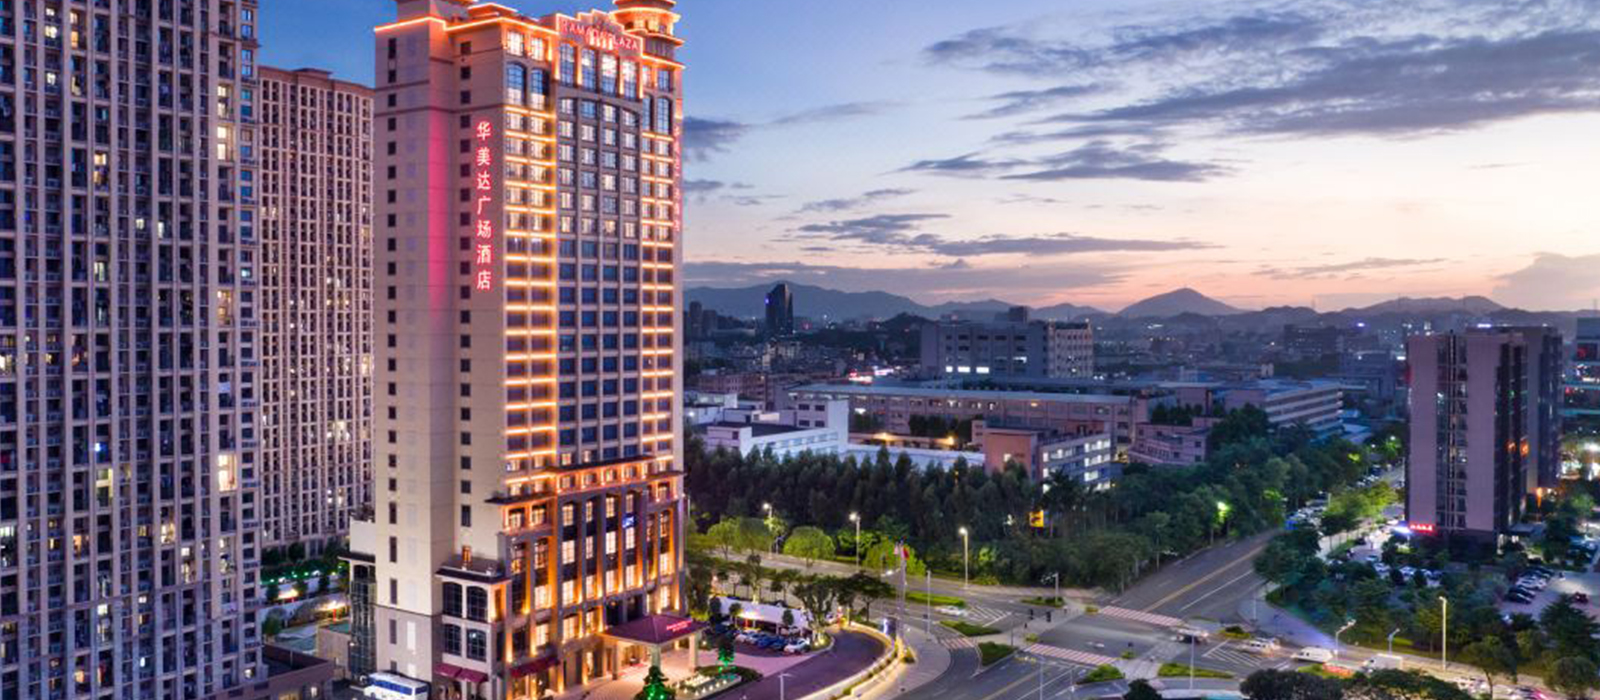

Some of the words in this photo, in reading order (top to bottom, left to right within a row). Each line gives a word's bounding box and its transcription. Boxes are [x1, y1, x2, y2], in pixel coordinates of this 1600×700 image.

[476, 121, 492, 290] 华美达广场酒店
